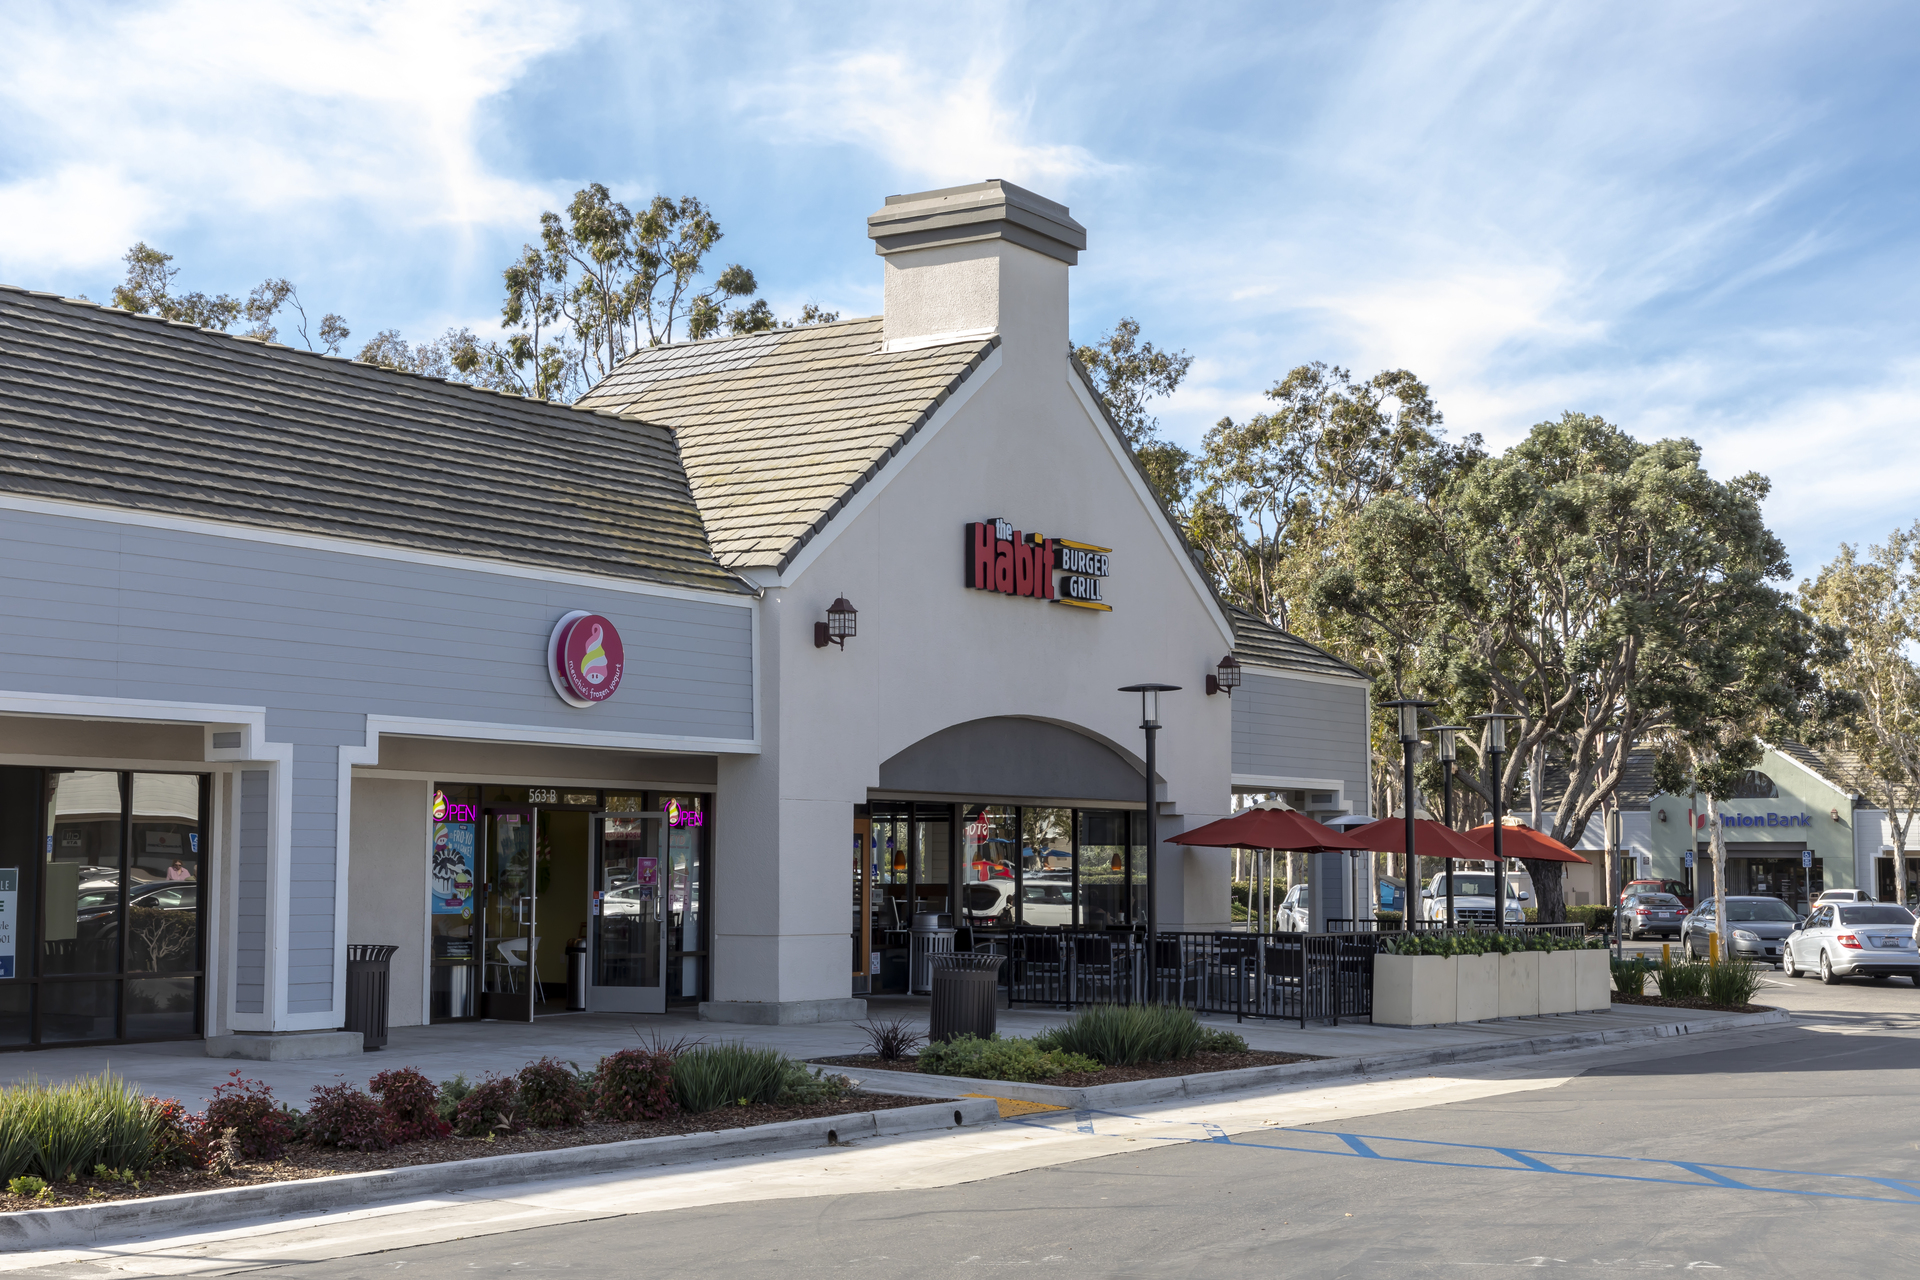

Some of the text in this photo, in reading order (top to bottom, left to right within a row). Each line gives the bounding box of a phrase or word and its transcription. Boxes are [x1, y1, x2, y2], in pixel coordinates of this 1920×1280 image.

[995, 517, 1013, 541] the
[974, 521, 1055, 599] Habit
[1062, 548, 1110, 577] BURGER
[1069, 576, 1102, 600] GRILL
[569, 660, 622, 700] menchie's frozen yogurt
[433, 793, 476, 822] OPEN
[528, 788, 557, 803] 563-B
[664, 800, 703, 827] OPEN
[453, 829, 473, 845] FRO-YO
